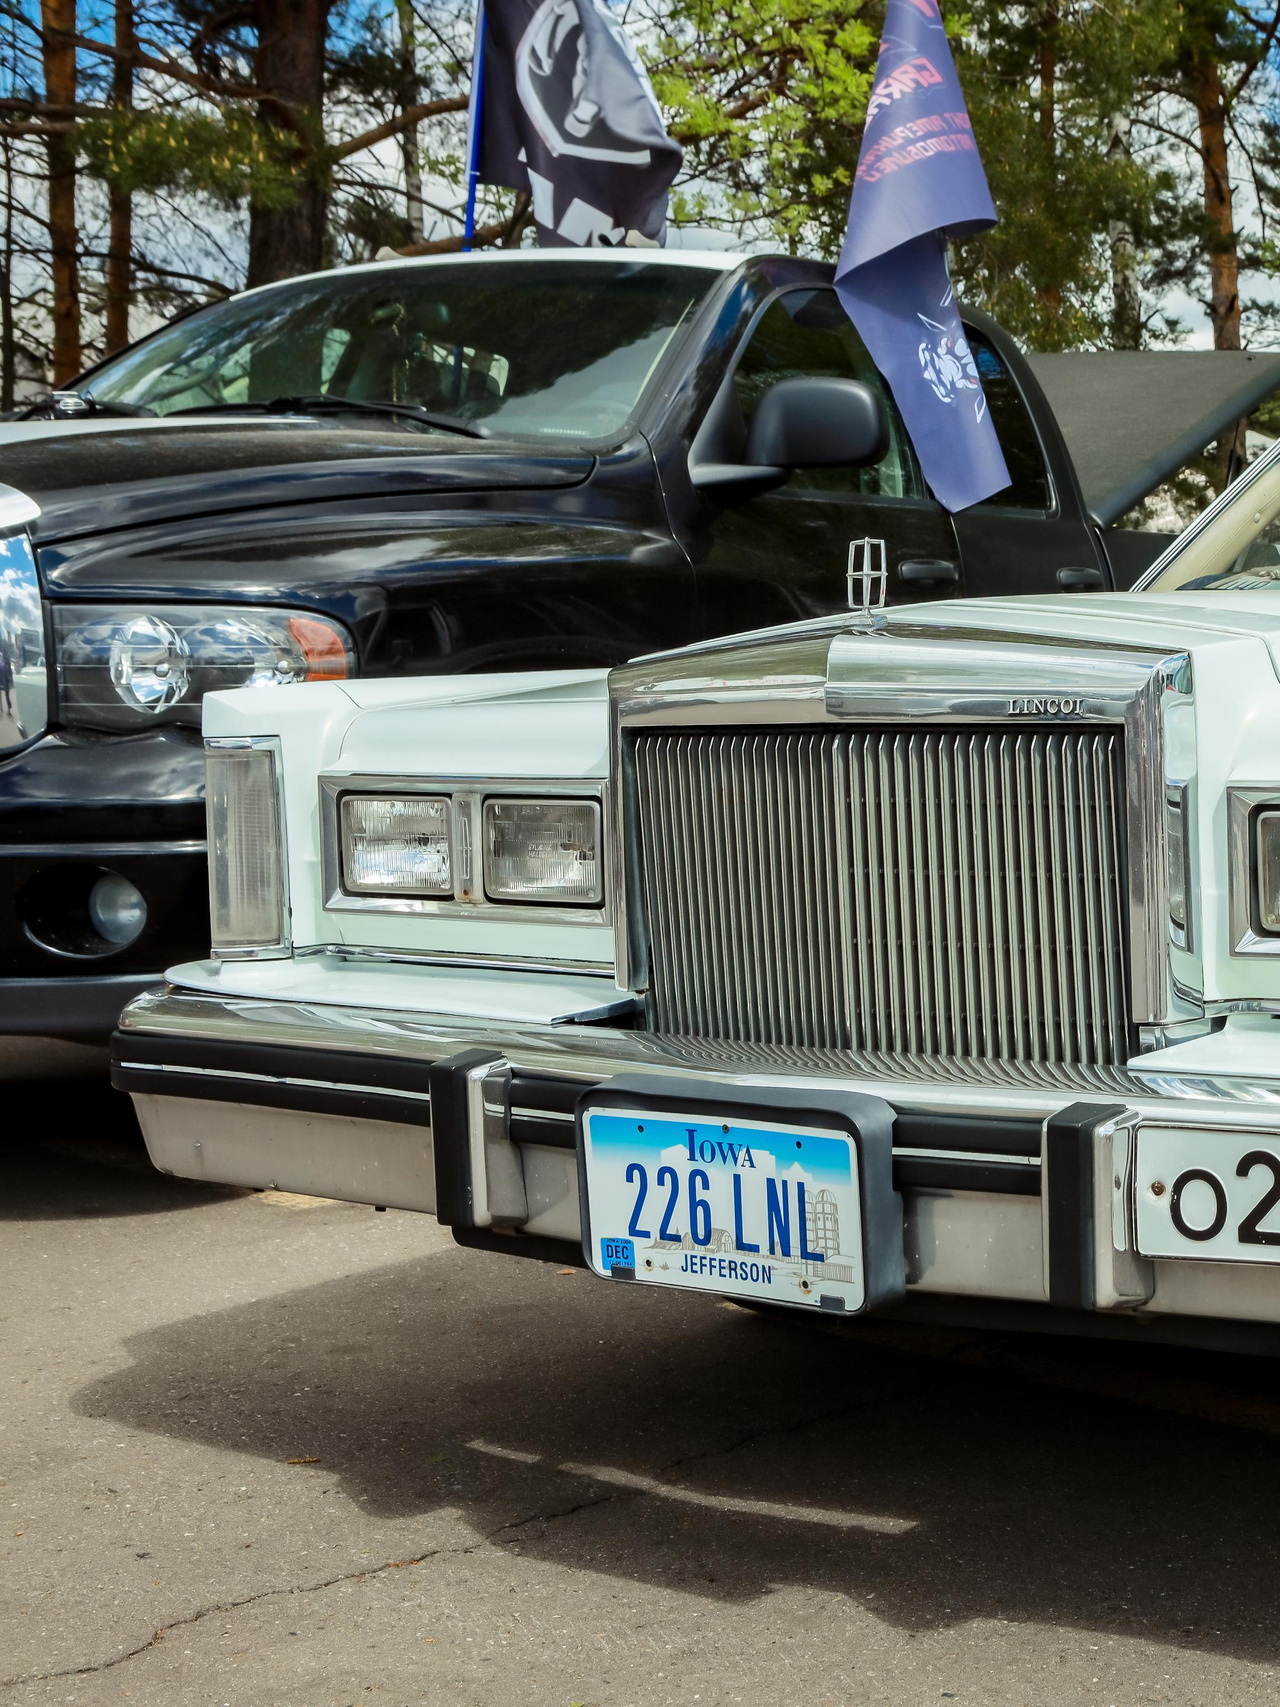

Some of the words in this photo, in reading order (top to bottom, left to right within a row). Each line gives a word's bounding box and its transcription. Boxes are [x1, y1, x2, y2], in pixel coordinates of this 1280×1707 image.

[625, 1162, 712, 1247] 226
[733, 1173, 825, 1263] LNL
[606, 1244, 629, 1260] DEC
[681, 1254, 772, 1285] JEFFERSON
